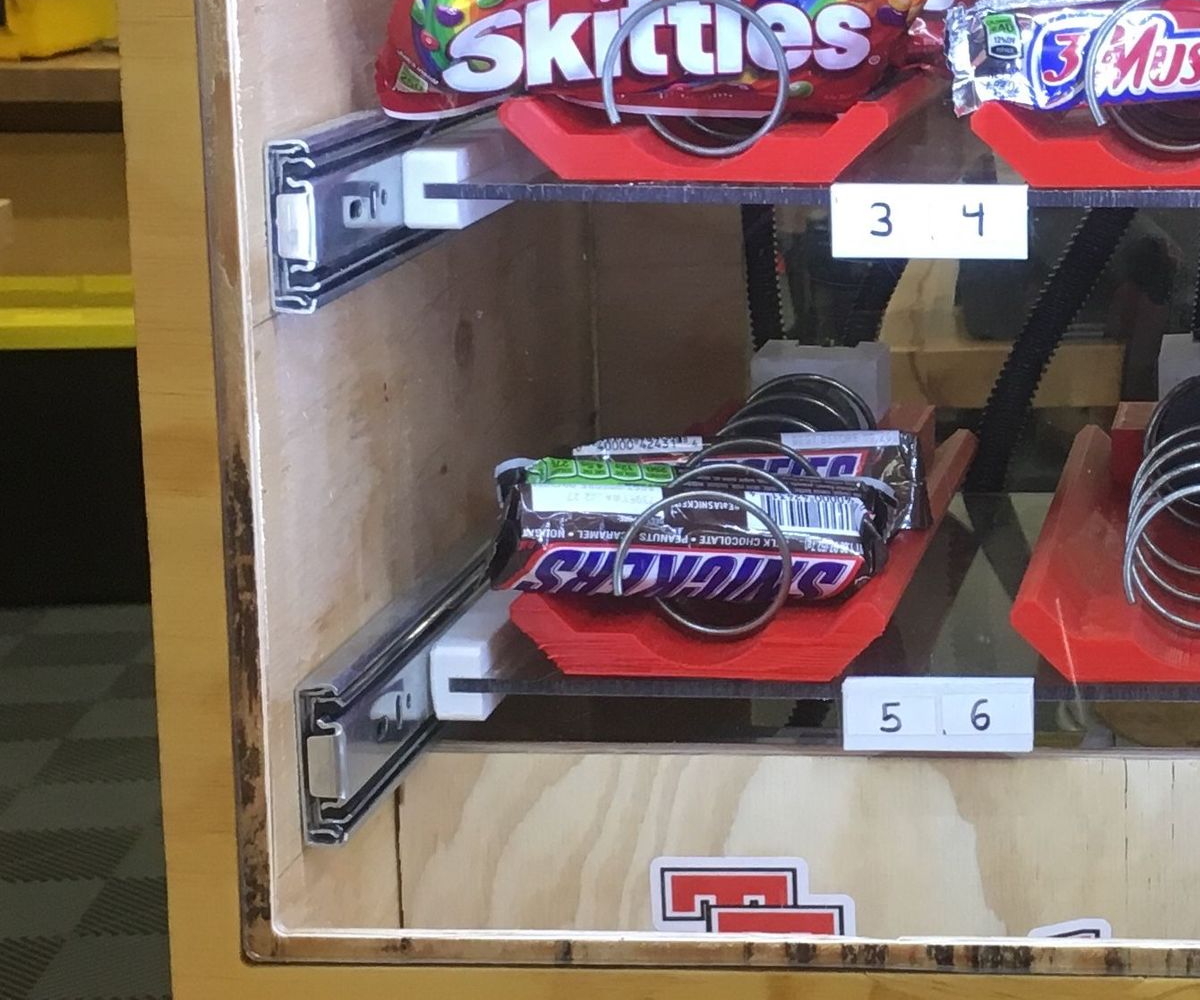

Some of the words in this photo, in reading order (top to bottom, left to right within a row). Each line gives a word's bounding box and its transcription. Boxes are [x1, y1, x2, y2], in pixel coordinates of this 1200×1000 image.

[1042, 33, 1086, 83] 3
[870, 202, 893, 237] 3
[963, 202, 984, 237] 4
[638, 530, 688, 544] PEANUTS
[699, 534, 761, 547] CHOCOLATE
[880, 701, 903, 733] 5
[970, 698, 991, 732] 6
